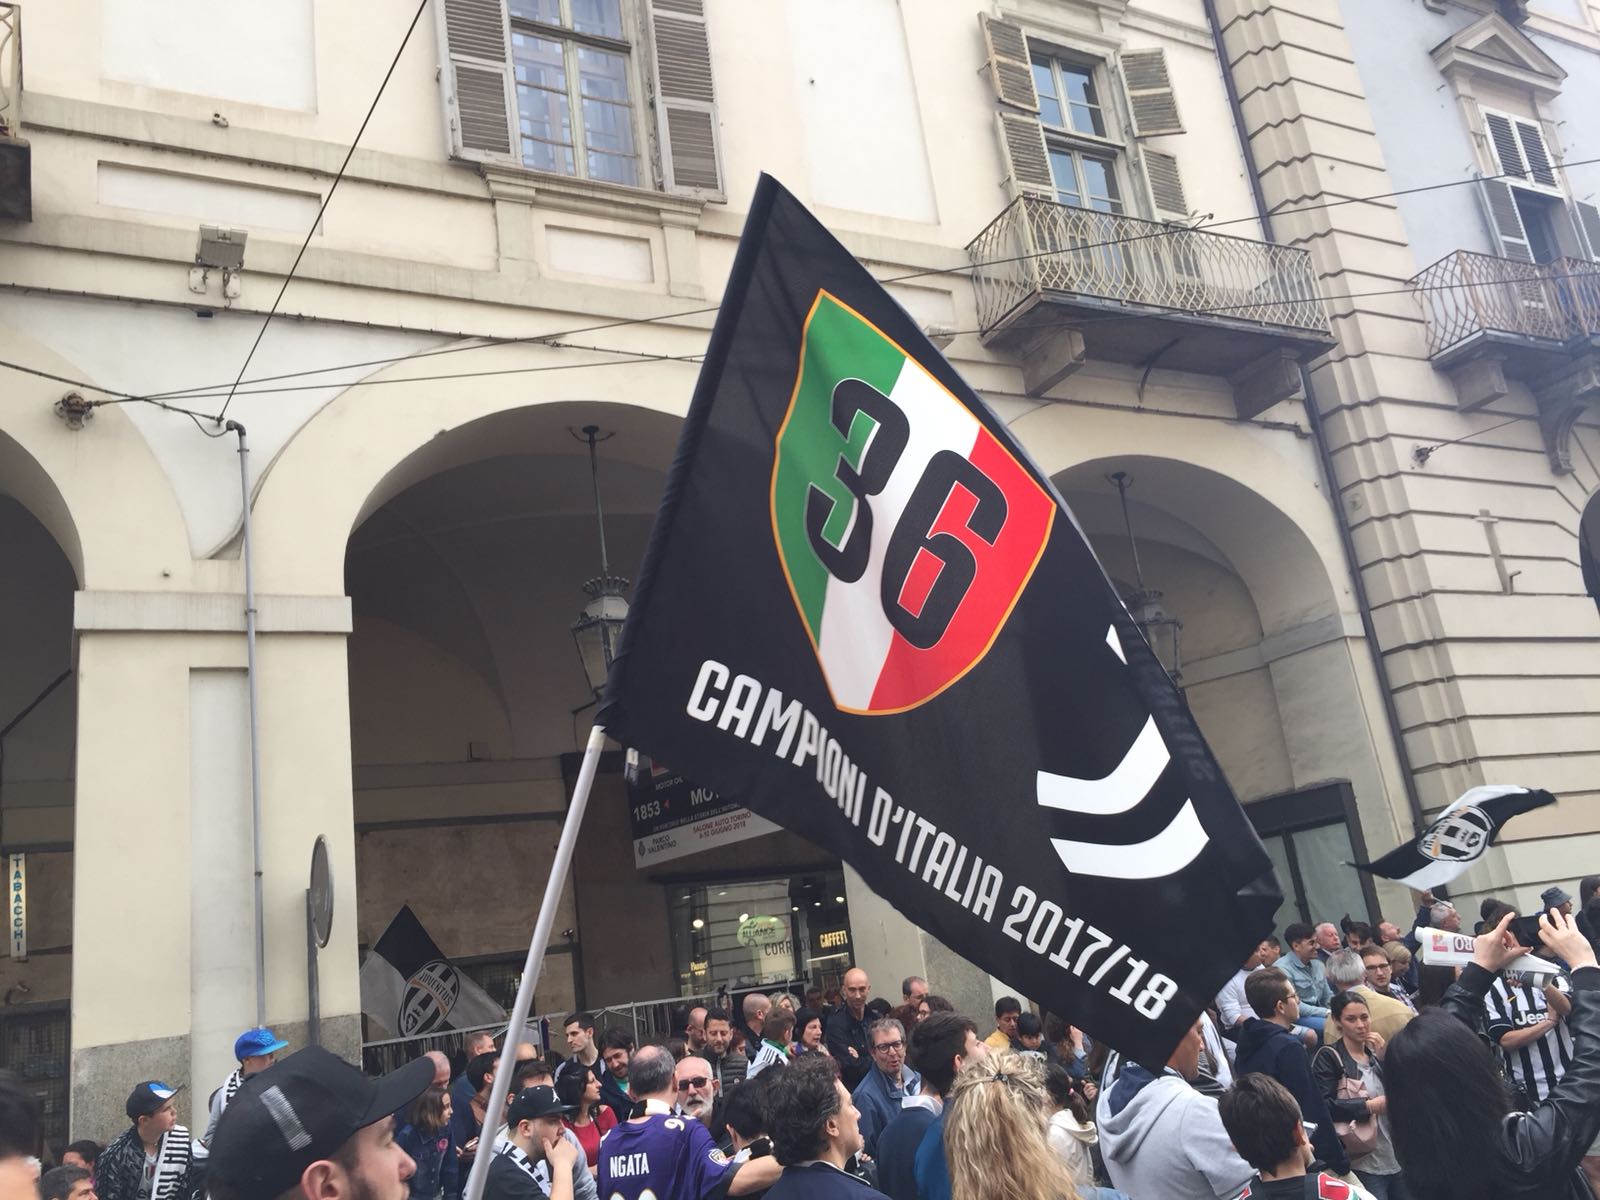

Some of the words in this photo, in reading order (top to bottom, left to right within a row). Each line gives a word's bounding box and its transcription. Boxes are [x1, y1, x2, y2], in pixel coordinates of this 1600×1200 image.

[806, 377, 1010, 651] 36
[633, 800, 661, 822] 1853
[714, 818, 730, 828] AUTO
[730, 812, 751, 824] TORINO
[652, 835, 671, 845] PARCO
[685, 658, 868, 827] CAMPIONI
[866, 786, 1004, 923] D'ITALIA
[1001, 885, 1179, 1021] 2017/18
[13, 858, 23, 951] TABACCHI
[419, 972, 453, 1006] JUVENTUS
[610, 1153, 650, 1178] NGATA
